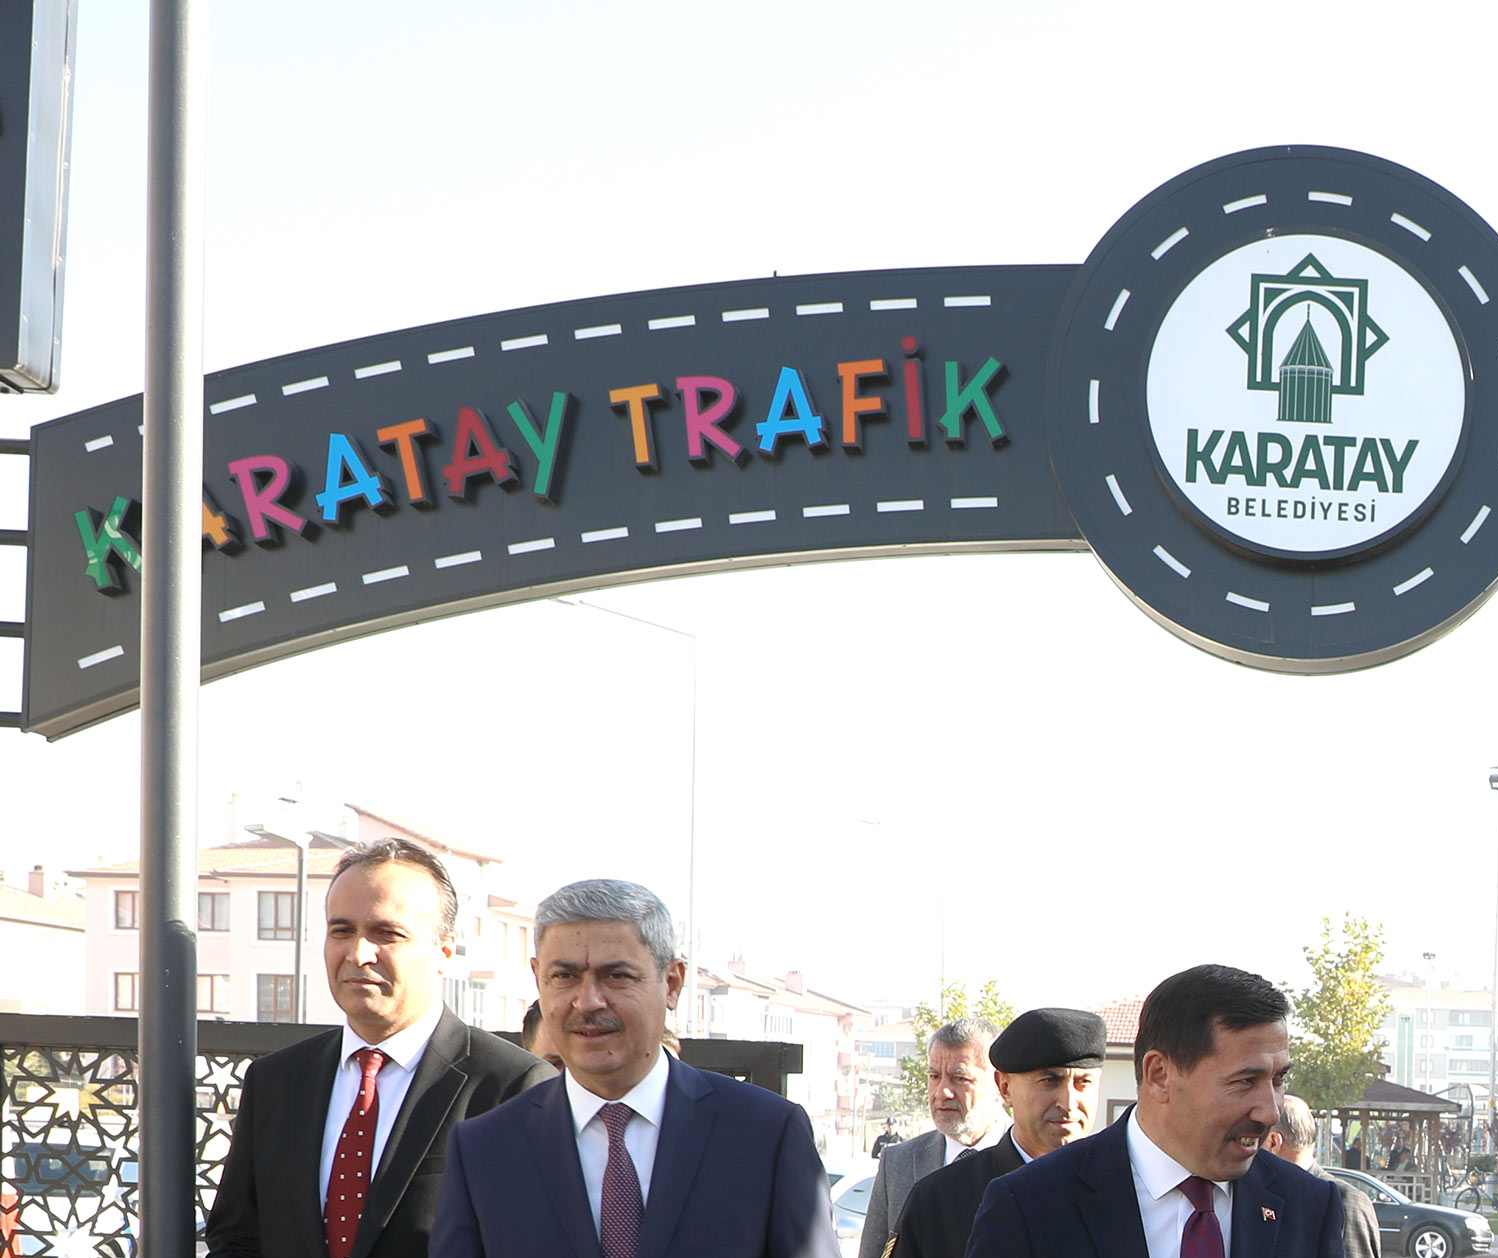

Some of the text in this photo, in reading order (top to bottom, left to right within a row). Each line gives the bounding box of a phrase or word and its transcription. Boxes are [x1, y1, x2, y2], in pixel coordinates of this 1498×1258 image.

[609, 336, 1005, 466] TRAFİK
[1185, 428, 1420, 493] KARATAY
[1227, 496, 1376, 522] BELEDİYESİ
